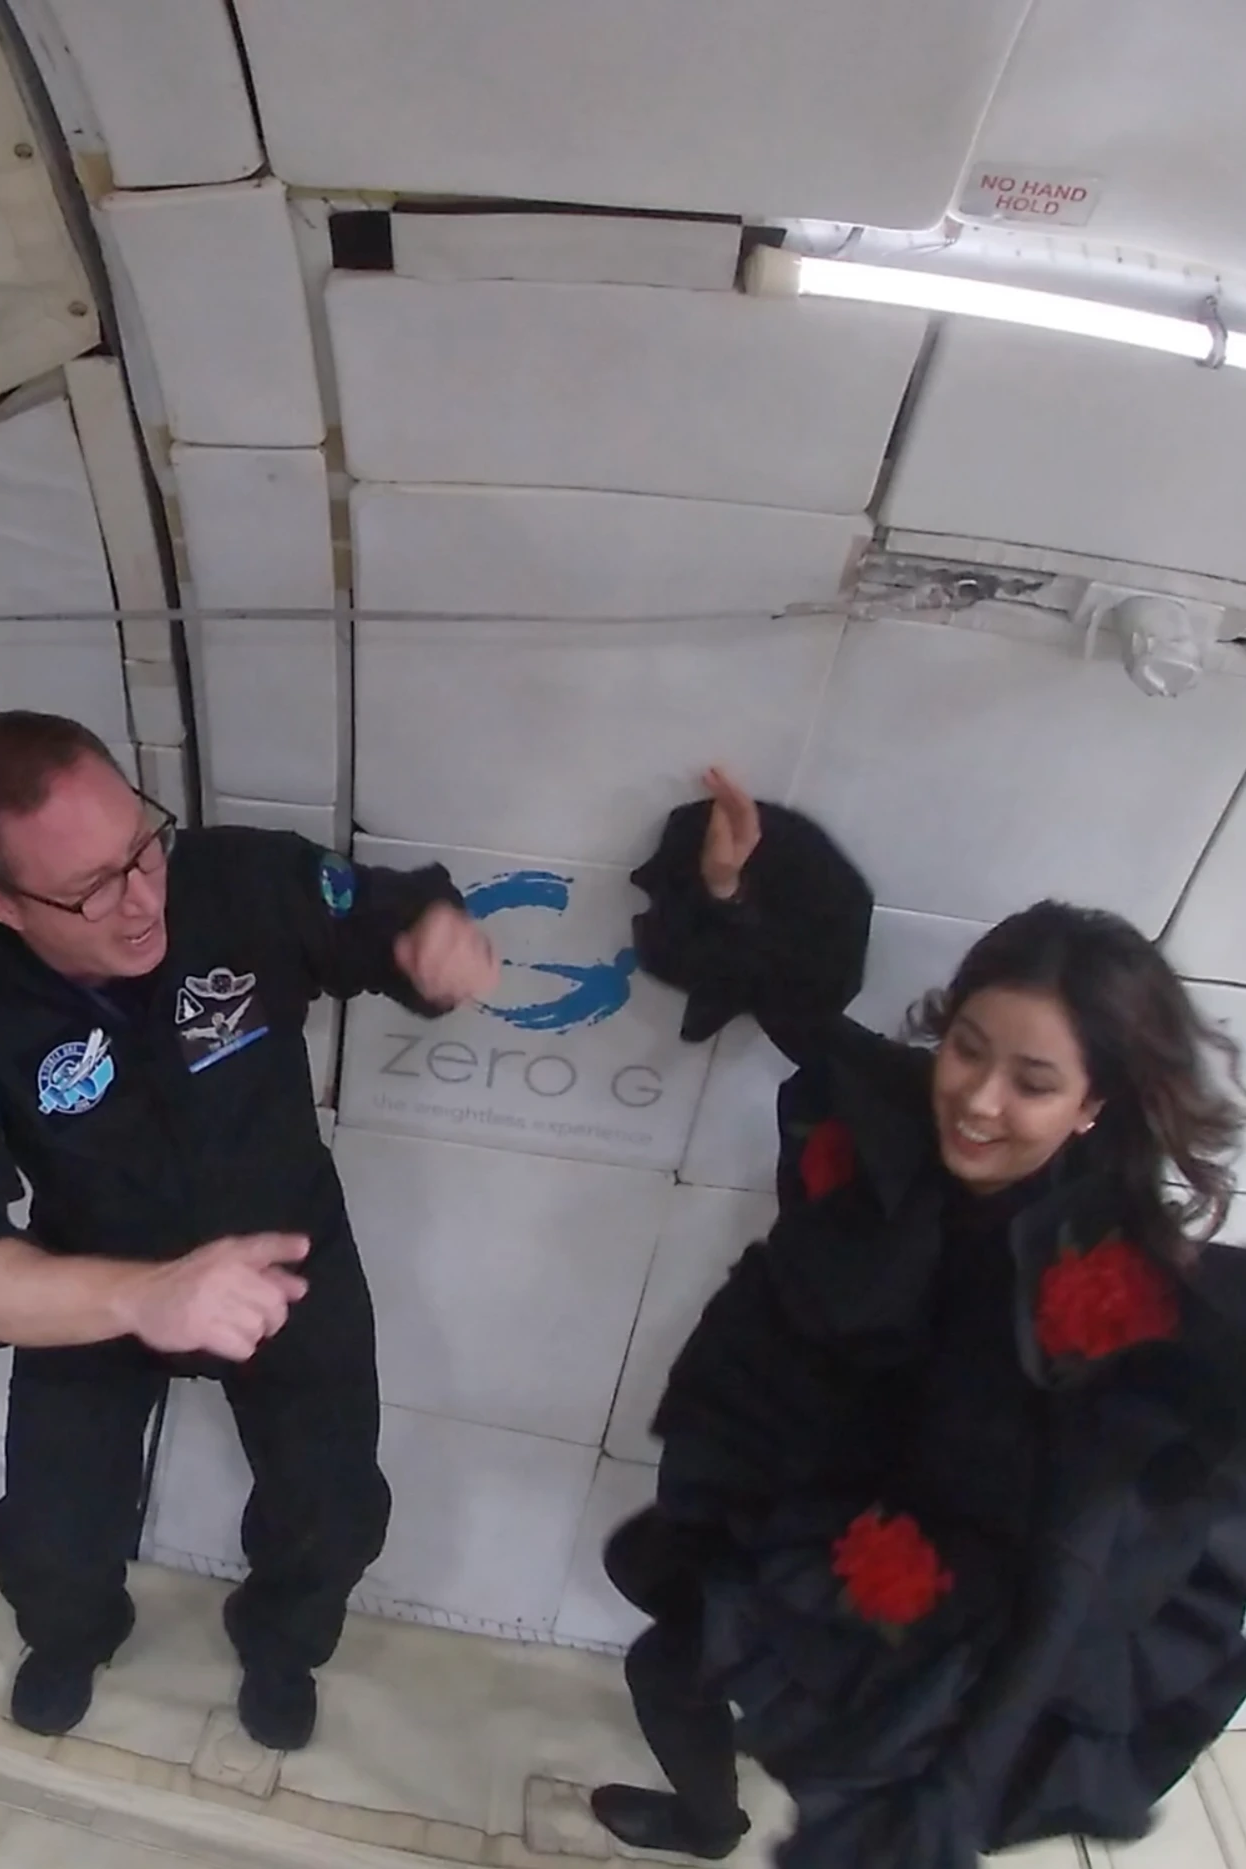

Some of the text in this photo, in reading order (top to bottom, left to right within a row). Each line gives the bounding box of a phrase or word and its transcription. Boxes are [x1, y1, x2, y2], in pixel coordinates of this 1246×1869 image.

[980, 174, 1087, 202] NO HAND
[996, 195, 1059, 215] HOLD
[379, 1033, 663, 1107] zero G
[373, 1094, 653, 1146] the weightless experience
